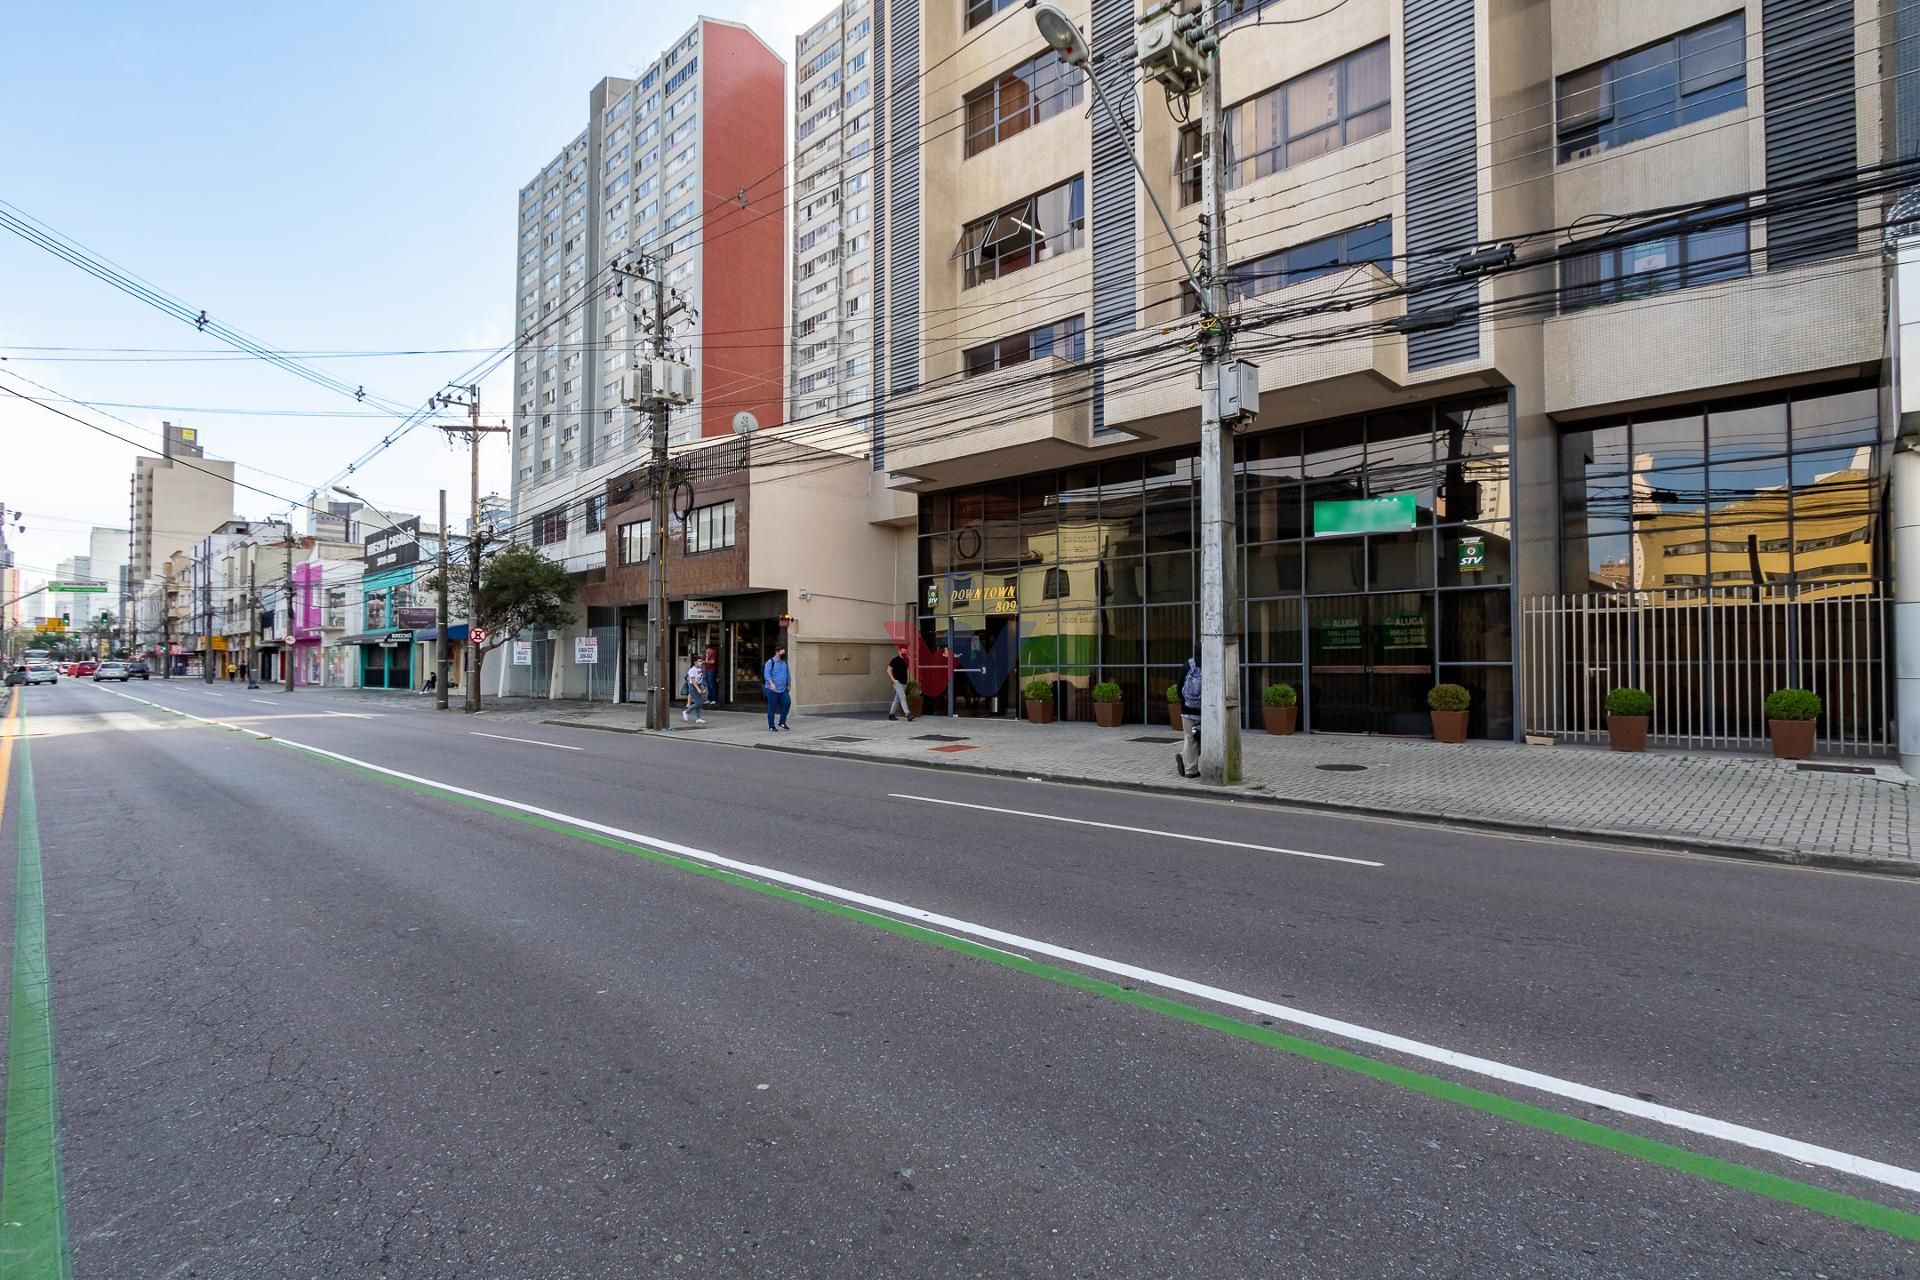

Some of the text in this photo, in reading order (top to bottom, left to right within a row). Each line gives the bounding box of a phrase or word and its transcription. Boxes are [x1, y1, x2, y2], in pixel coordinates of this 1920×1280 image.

[1459, 556, 1483, 565] STV
[951, 586, 1016, 601] DOWNTOWN
[995, 600, 1016, 612] 809
[1333, 619, 1360, 628] ALUGA
[1395, 617, 1424, 626] ALUGA
